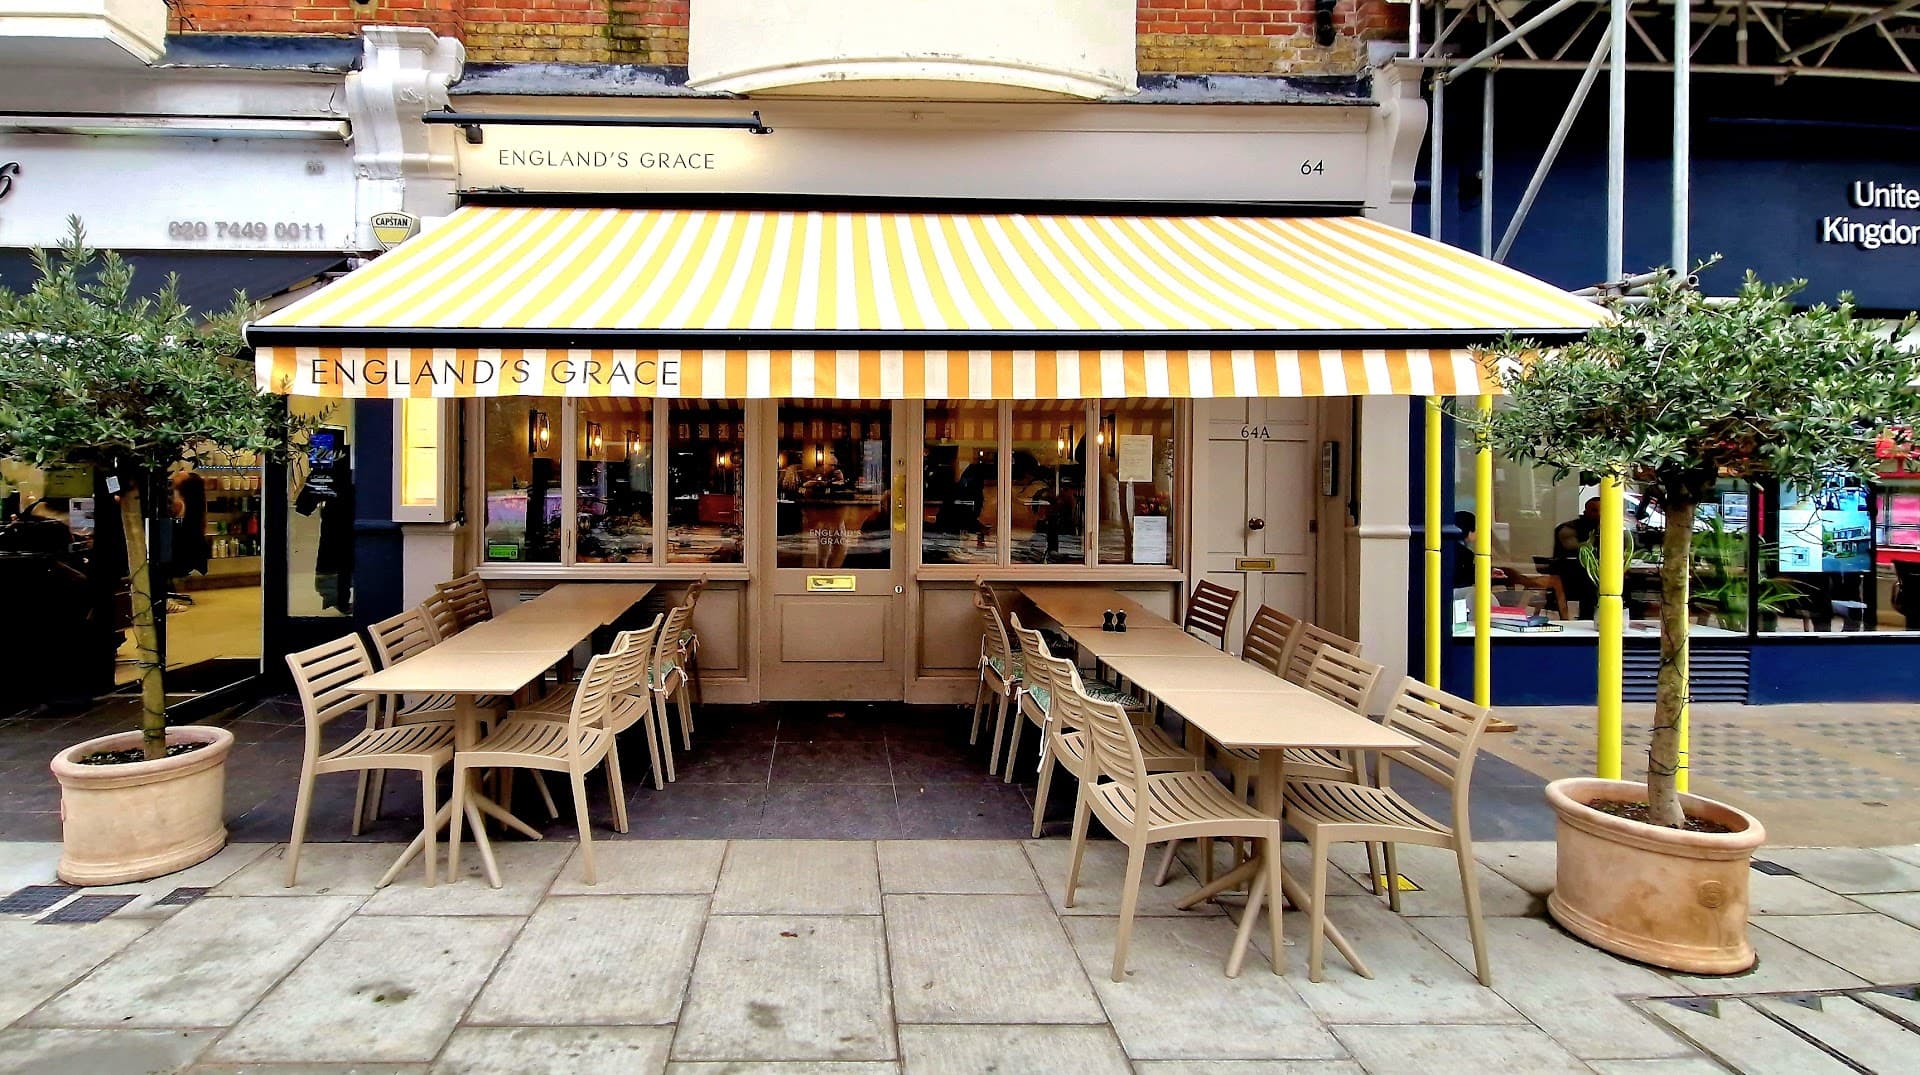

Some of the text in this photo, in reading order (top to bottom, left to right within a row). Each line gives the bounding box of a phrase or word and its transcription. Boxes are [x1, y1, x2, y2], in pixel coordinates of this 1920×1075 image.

[499, 149, 715, 170] ENGLAND'S GRACE
[1300, 159, 1325, 176] 64
[1854, 180, 1920, 208] Unite
[168, 220, 325, 241] 020 7449 0011
[375, 217, 408, 226] CAPSTAN
[311, 359, 680, 386] ENGLAND'S GRACE
[1241, 425, 1270, 439] 64A
